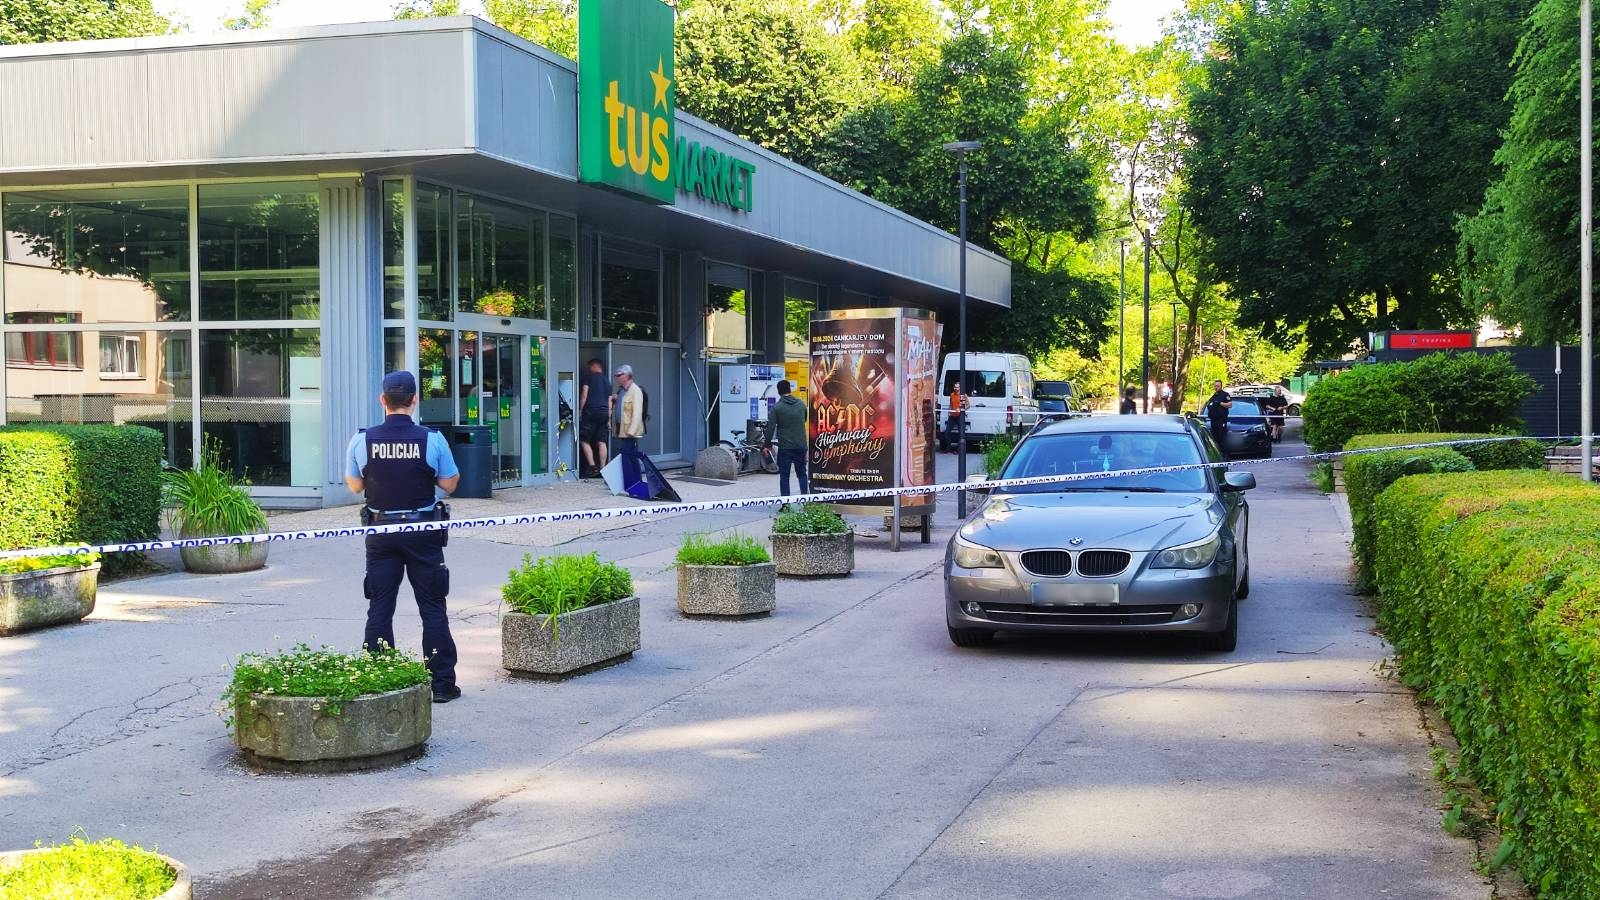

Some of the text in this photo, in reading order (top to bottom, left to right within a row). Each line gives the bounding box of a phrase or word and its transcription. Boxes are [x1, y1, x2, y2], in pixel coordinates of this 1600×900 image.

[675, 136, 756, 212] MARKET
[870, 333, 885, 341] DOM
[818, 428, 871, 448] Highway
[371, 443, 421, 459] POLICIJA
[847, 474, 884, 482] ORCHESTRA
